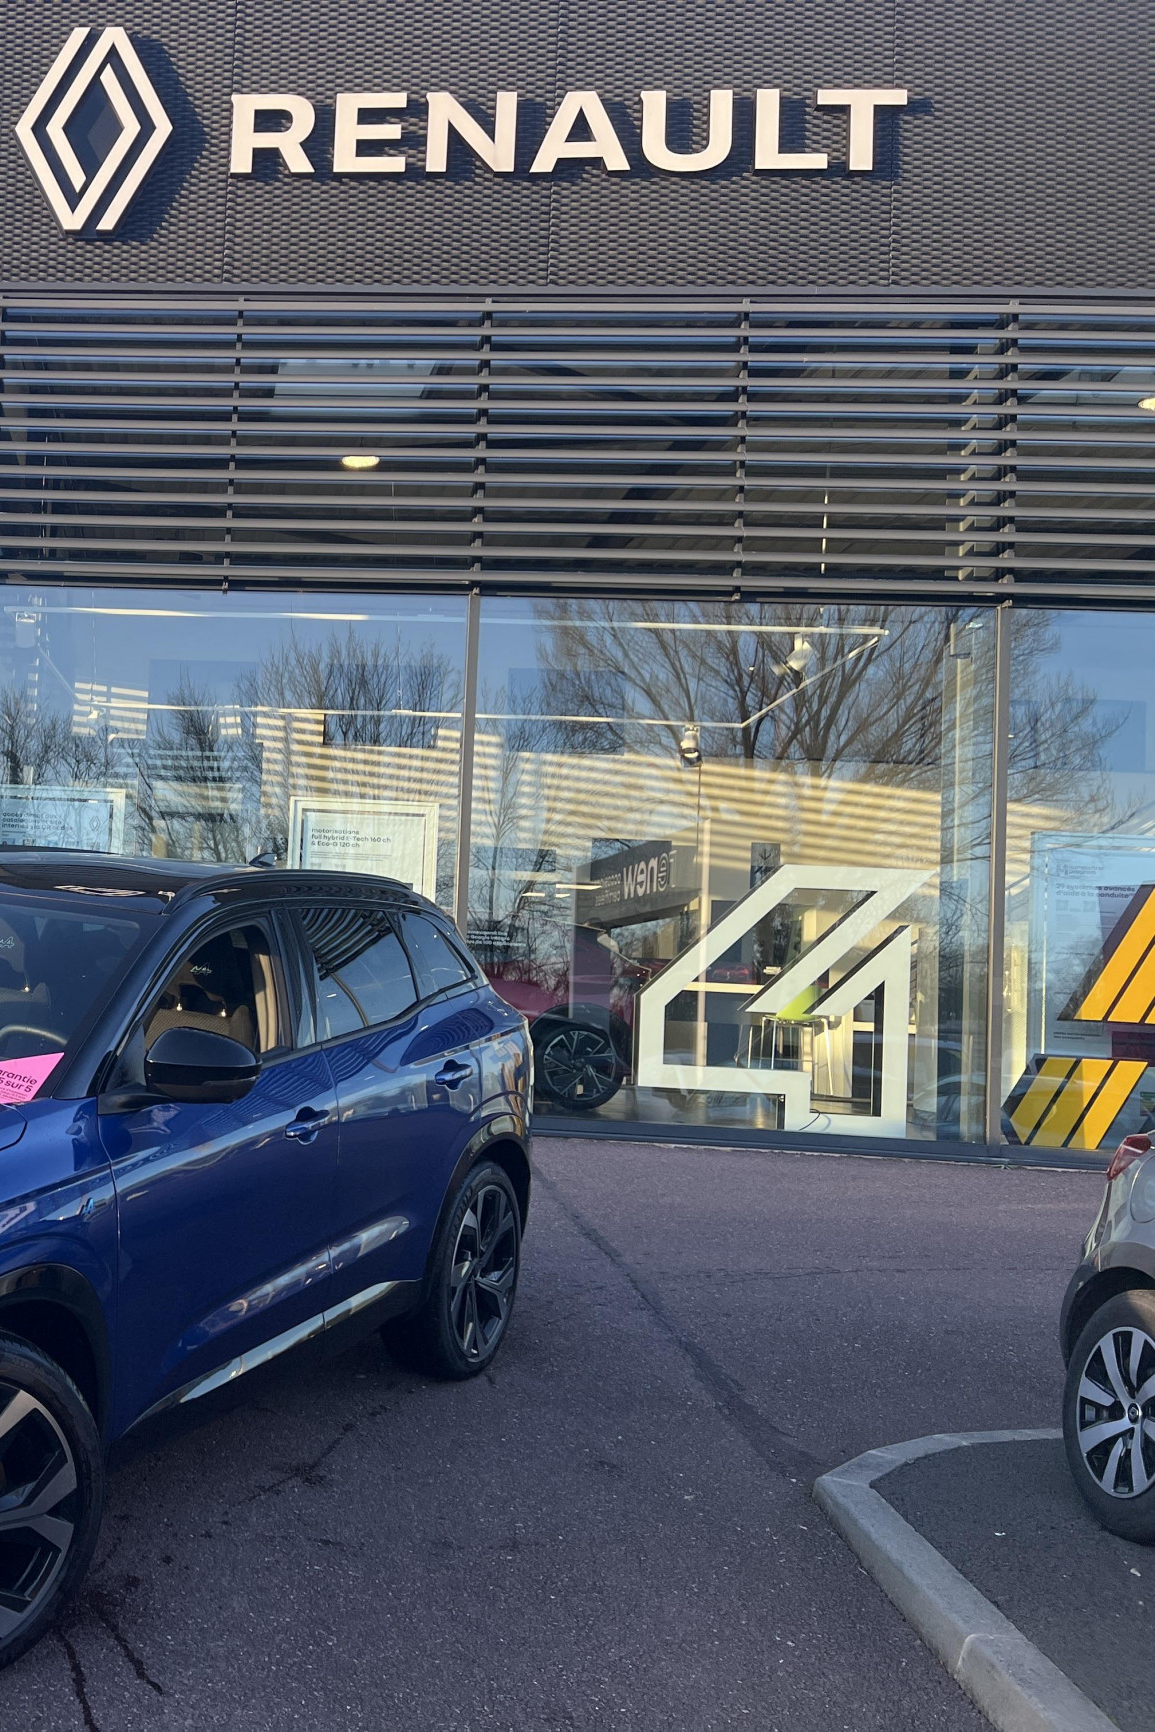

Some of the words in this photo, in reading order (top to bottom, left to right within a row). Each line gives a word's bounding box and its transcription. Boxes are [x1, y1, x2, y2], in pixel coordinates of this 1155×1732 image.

[230, 88, 908, 173] RENAULT
[5, 1079, 24, 1091] sur
[24, 1085, 34, 1093] 5
